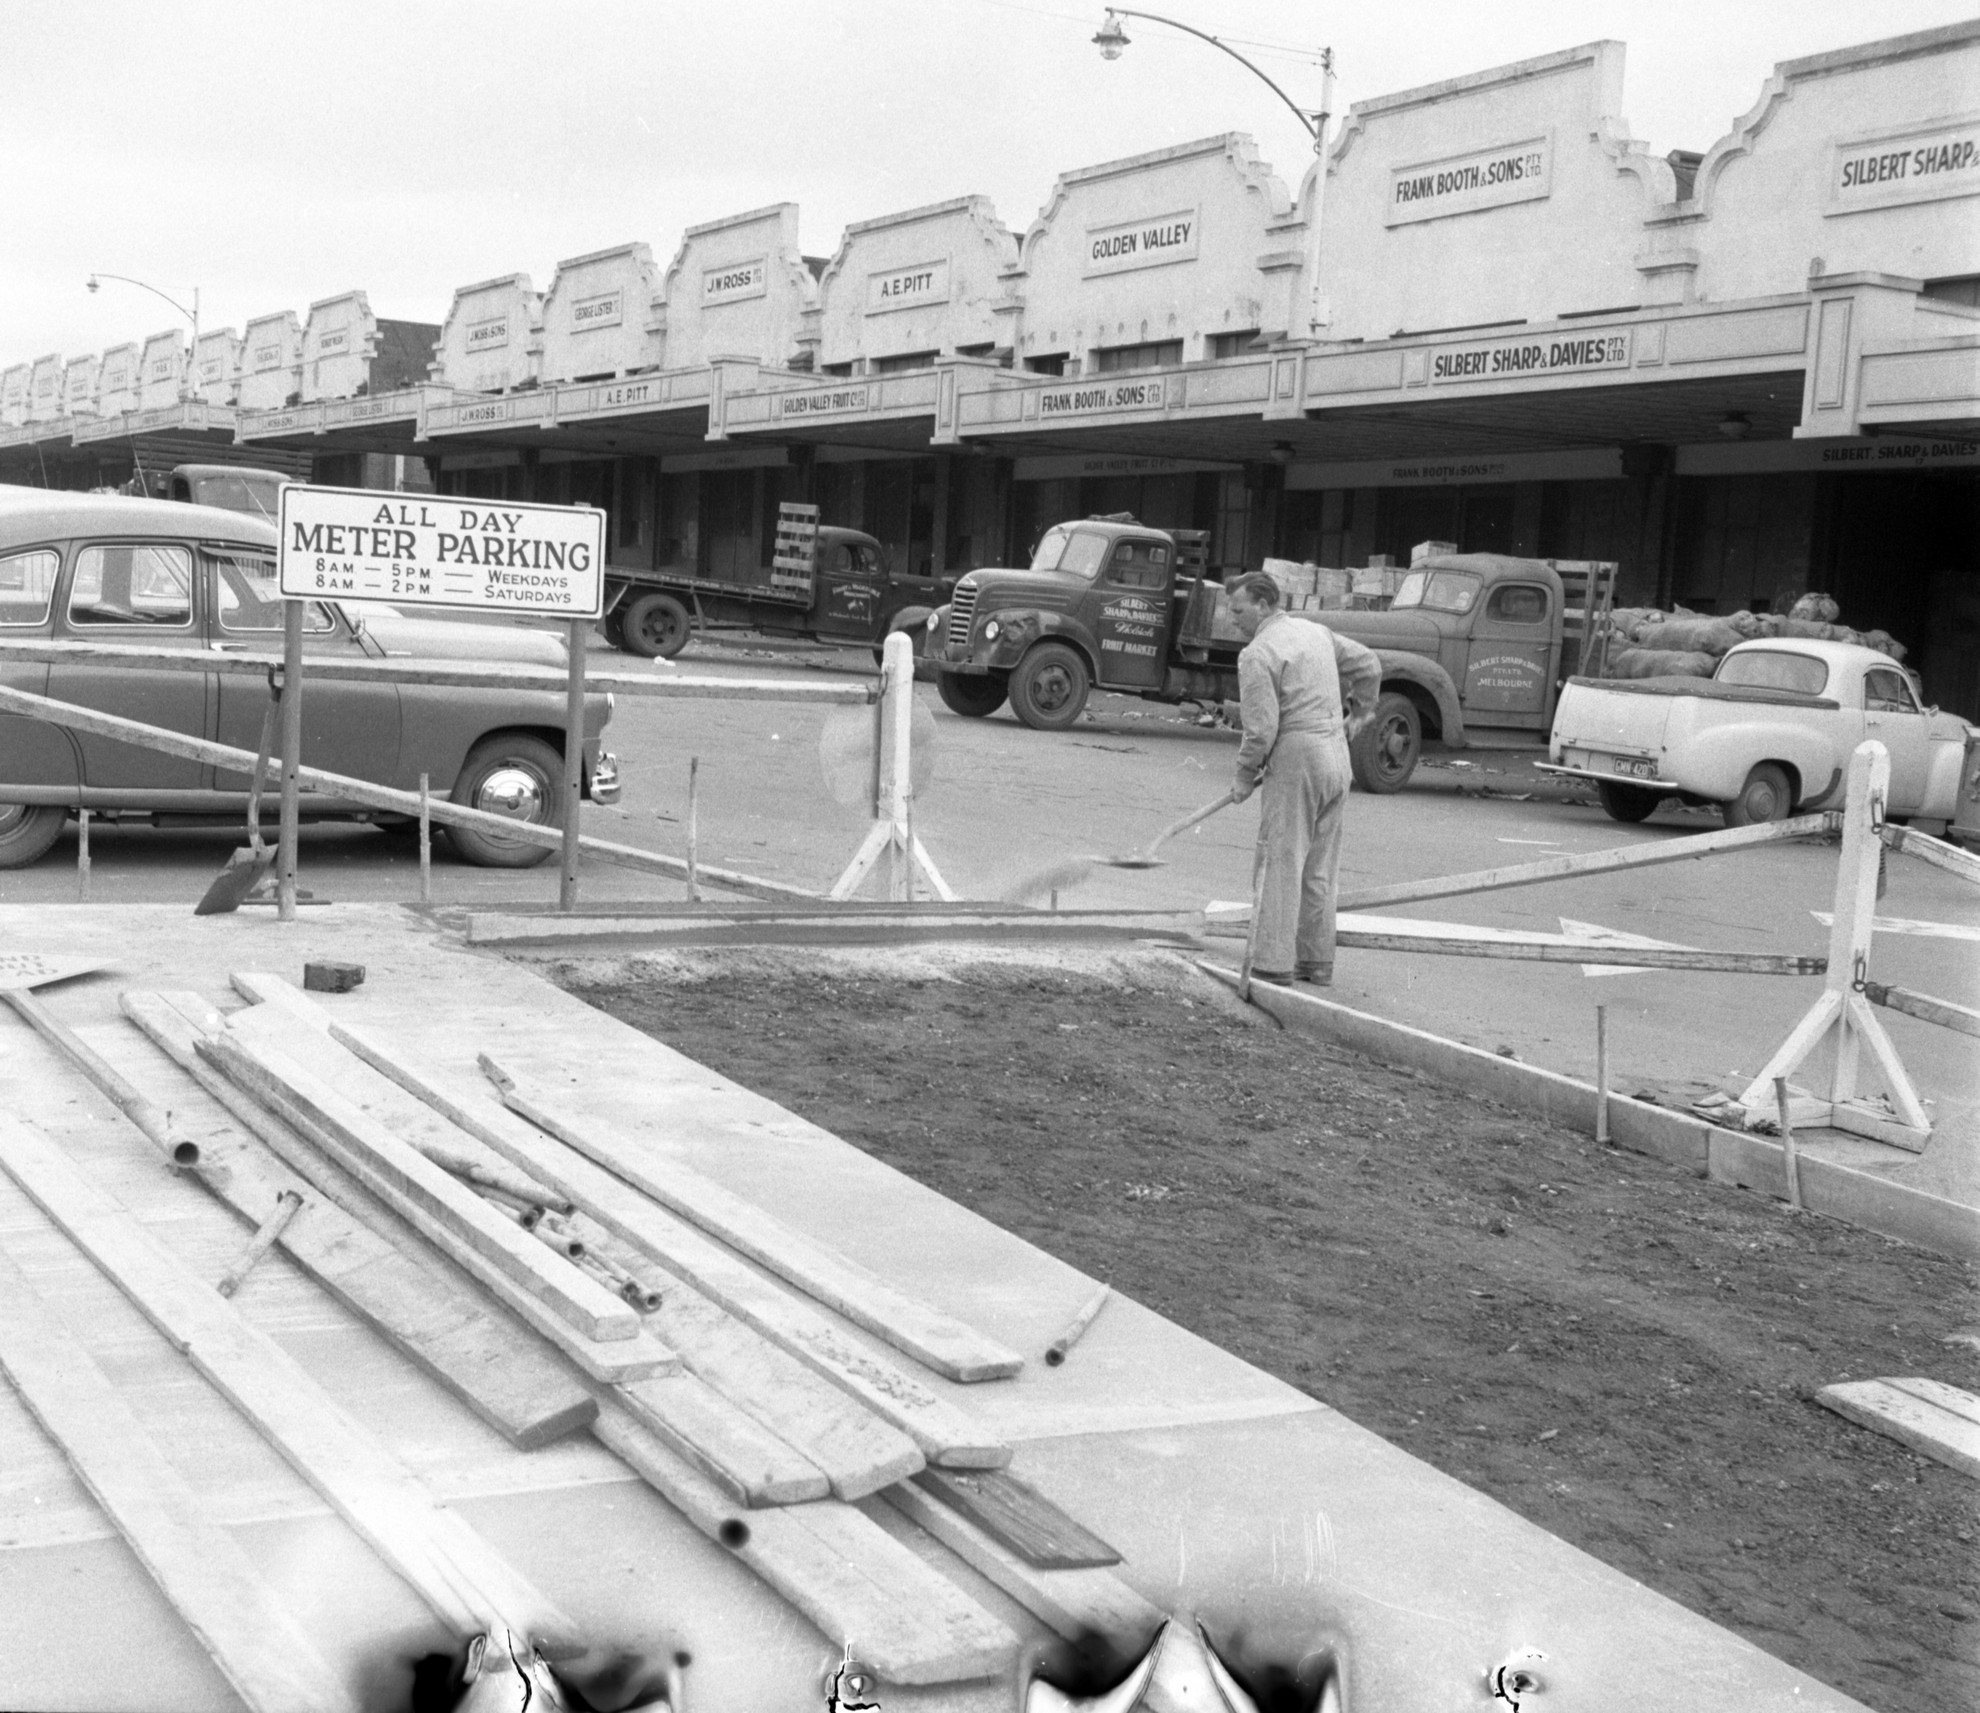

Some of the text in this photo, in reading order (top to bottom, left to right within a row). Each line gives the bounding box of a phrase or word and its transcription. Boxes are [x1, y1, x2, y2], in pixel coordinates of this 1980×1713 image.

[1841, 151, 1912, 188] SILBERT
[1913, 141, 1974, 176] SHARP
[1396, 174, 1434, 203] FRANK
[1437, 166, 1479, 195] BOOTH
[1487, 156, 1523, 184] SONS
[1092, 222, 1191, 260] GOLDEN VALLEY
[1434, 351, 1490, 378] SILBERT
[1492, 346, 1540, 373] SHARP
[1549, 338, 1605, 368] DAVIES
[784, 397, 807, 413] GOLDEN
[808, 394, 830, 411] VALLEY
[833, 392, 850, 408] FRUIT
[1042, 393, 1072, 412] FRANK
[1074, 390, 1106, 410] BOOTH
[1116, 386, 1145, 406] SONS
[1878, 445, 1920, 459] SHARP
[1931, 442, 1977, 457] DAVIES
[1393, 468, 1419, 479] FRANK
[1422, 466, 1454, 477] BOOTH
[1460, 464, 1488, 476] SONS
[373, 504, 523, 533] ALL DAY
[292, 522, 590, 572] METER PARKING
[316, 558, 325, 572] 8
[392, 564, 400, 576] 5
[316, 574, 325, 588] 8
[392, 580, 400, 592] 2
[1102, 638, 1158, 656] FRUIT MARKET
[1477, 678, 1533, 688] MELBOURNE
